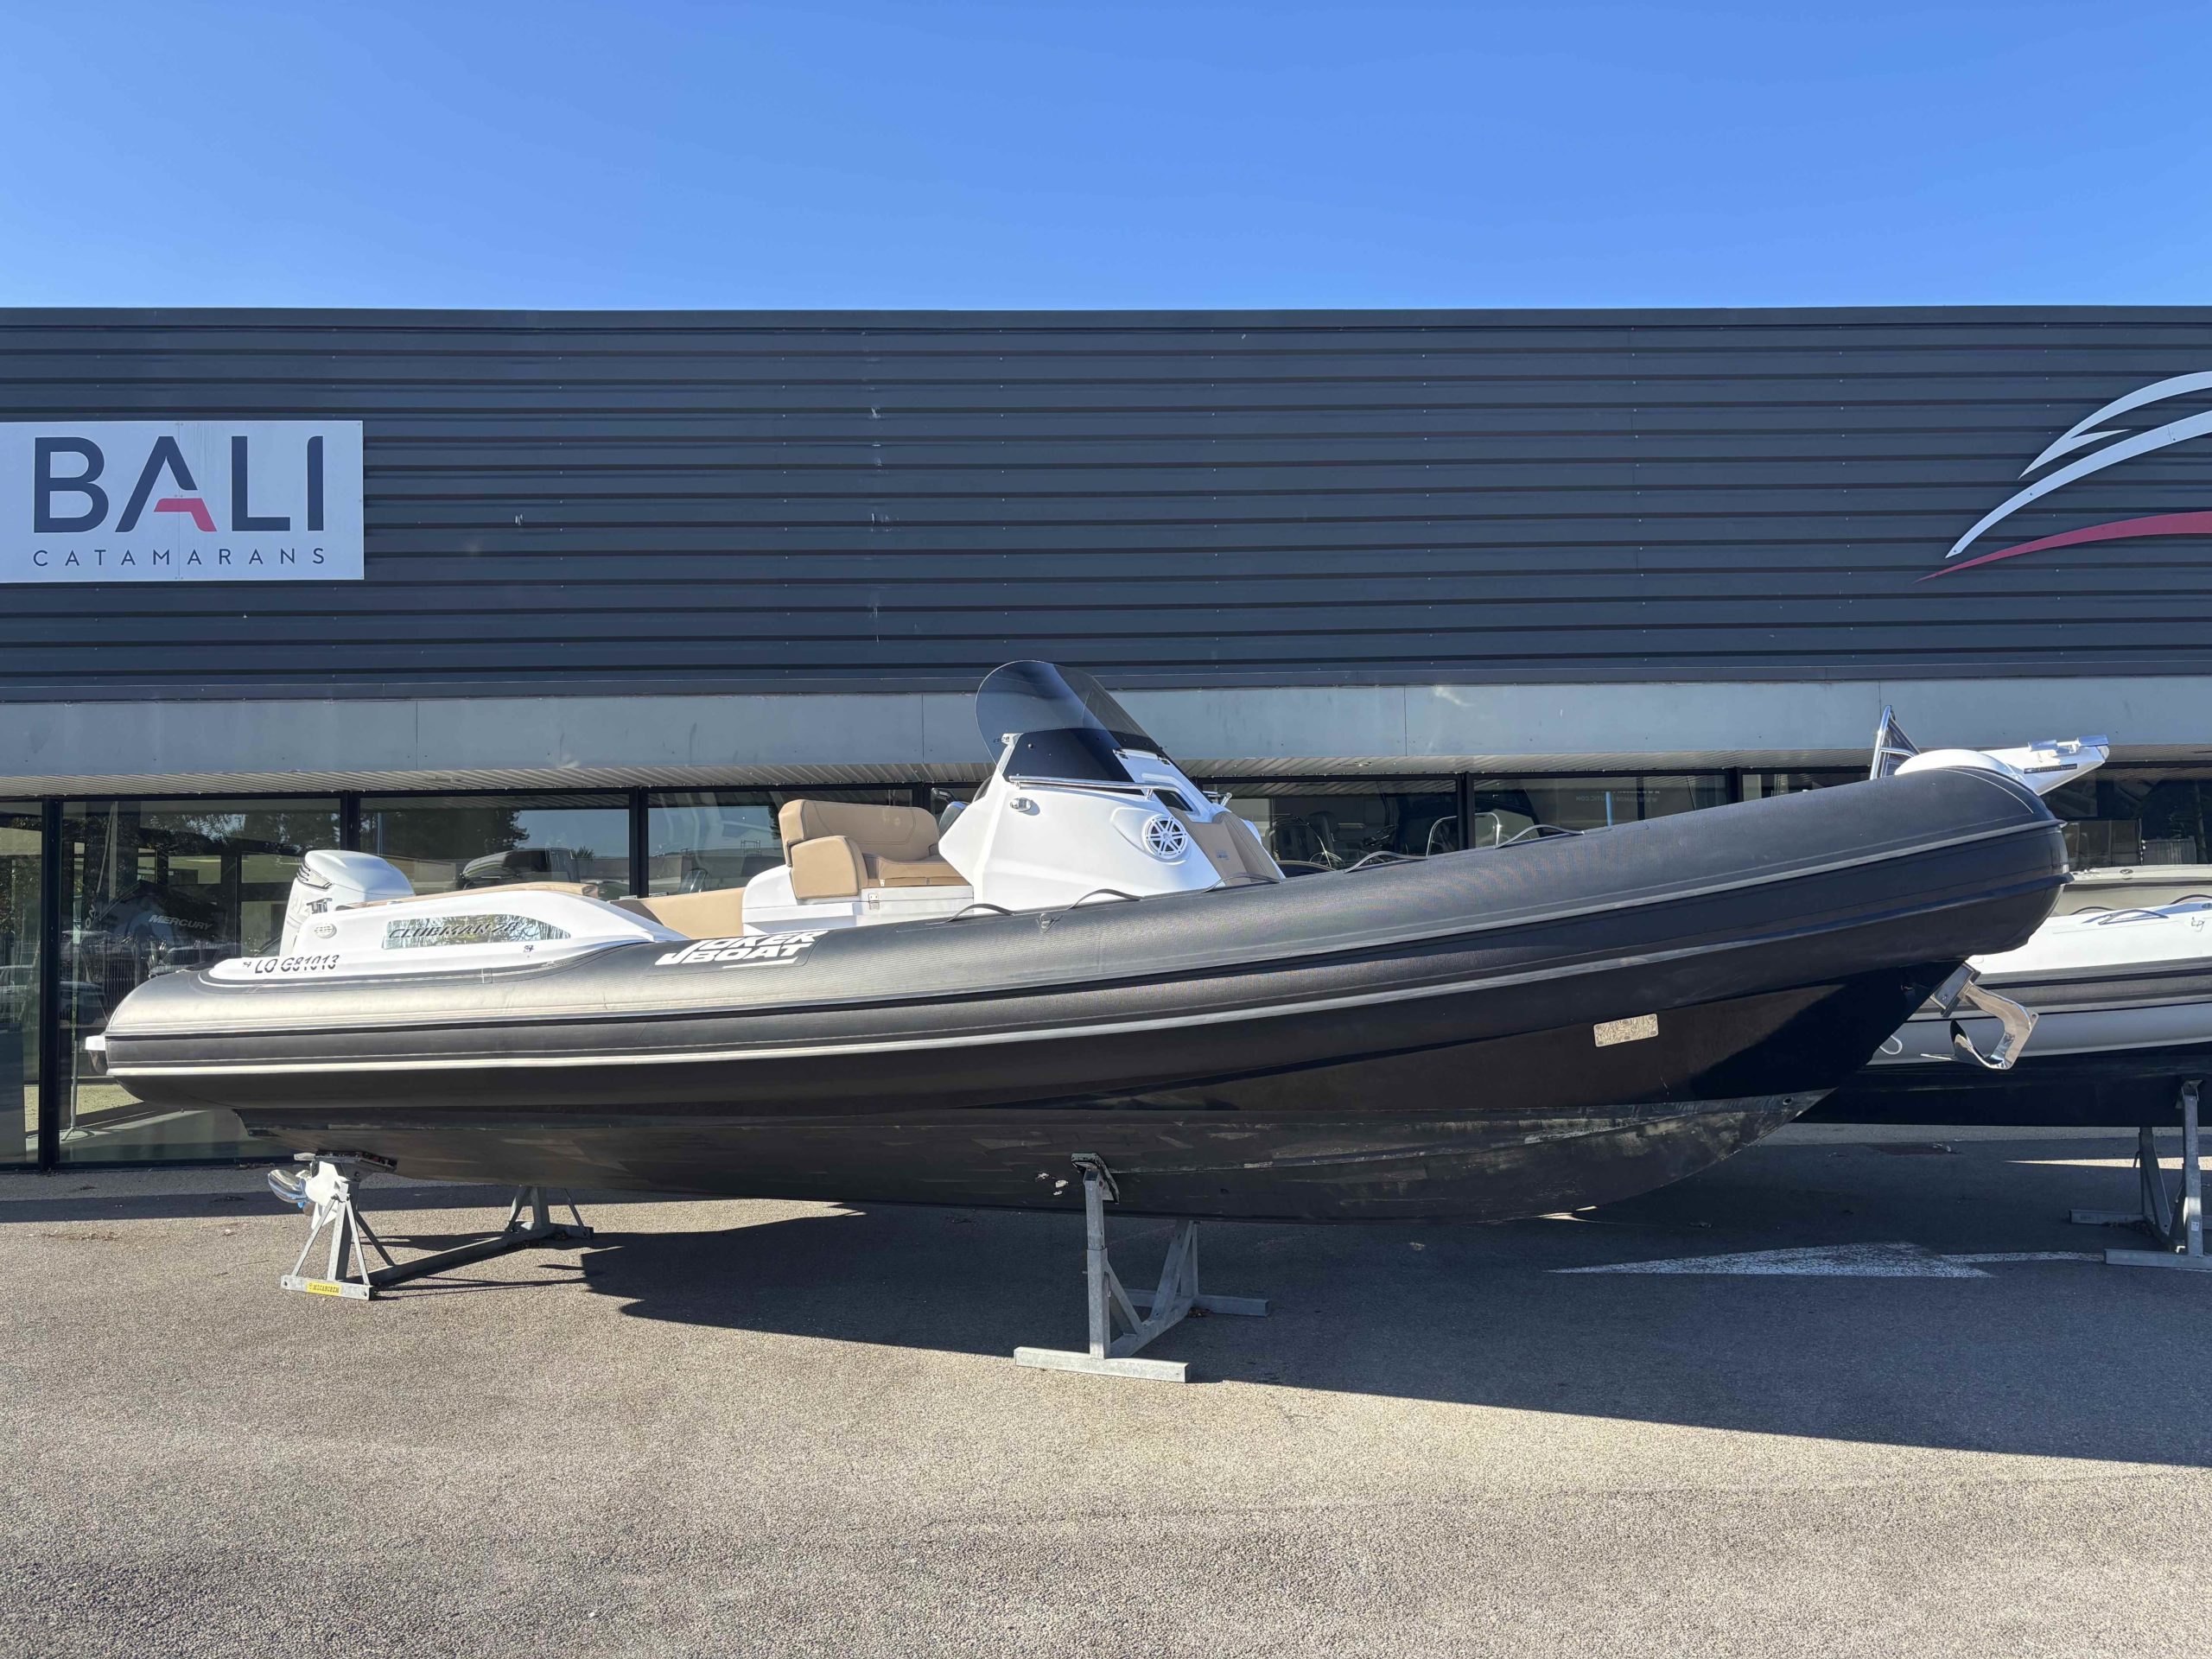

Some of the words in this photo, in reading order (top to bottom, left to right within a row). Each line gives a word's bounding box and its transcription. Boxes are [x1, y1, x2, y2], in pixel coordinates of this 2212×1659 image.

[34, 435, 324, 533] BALI
[33, 548, 325, 566] CATAMARANS
[149, 914, 213, 931] MERCURY
[389, 924, 490, 938] CLUBMAN
[492, 921, 519, 933] 28
[655, 930, 829, 966] JOKER
[681, 943, 814, 964] BOAT
[255, 959, 278, 974] LO
